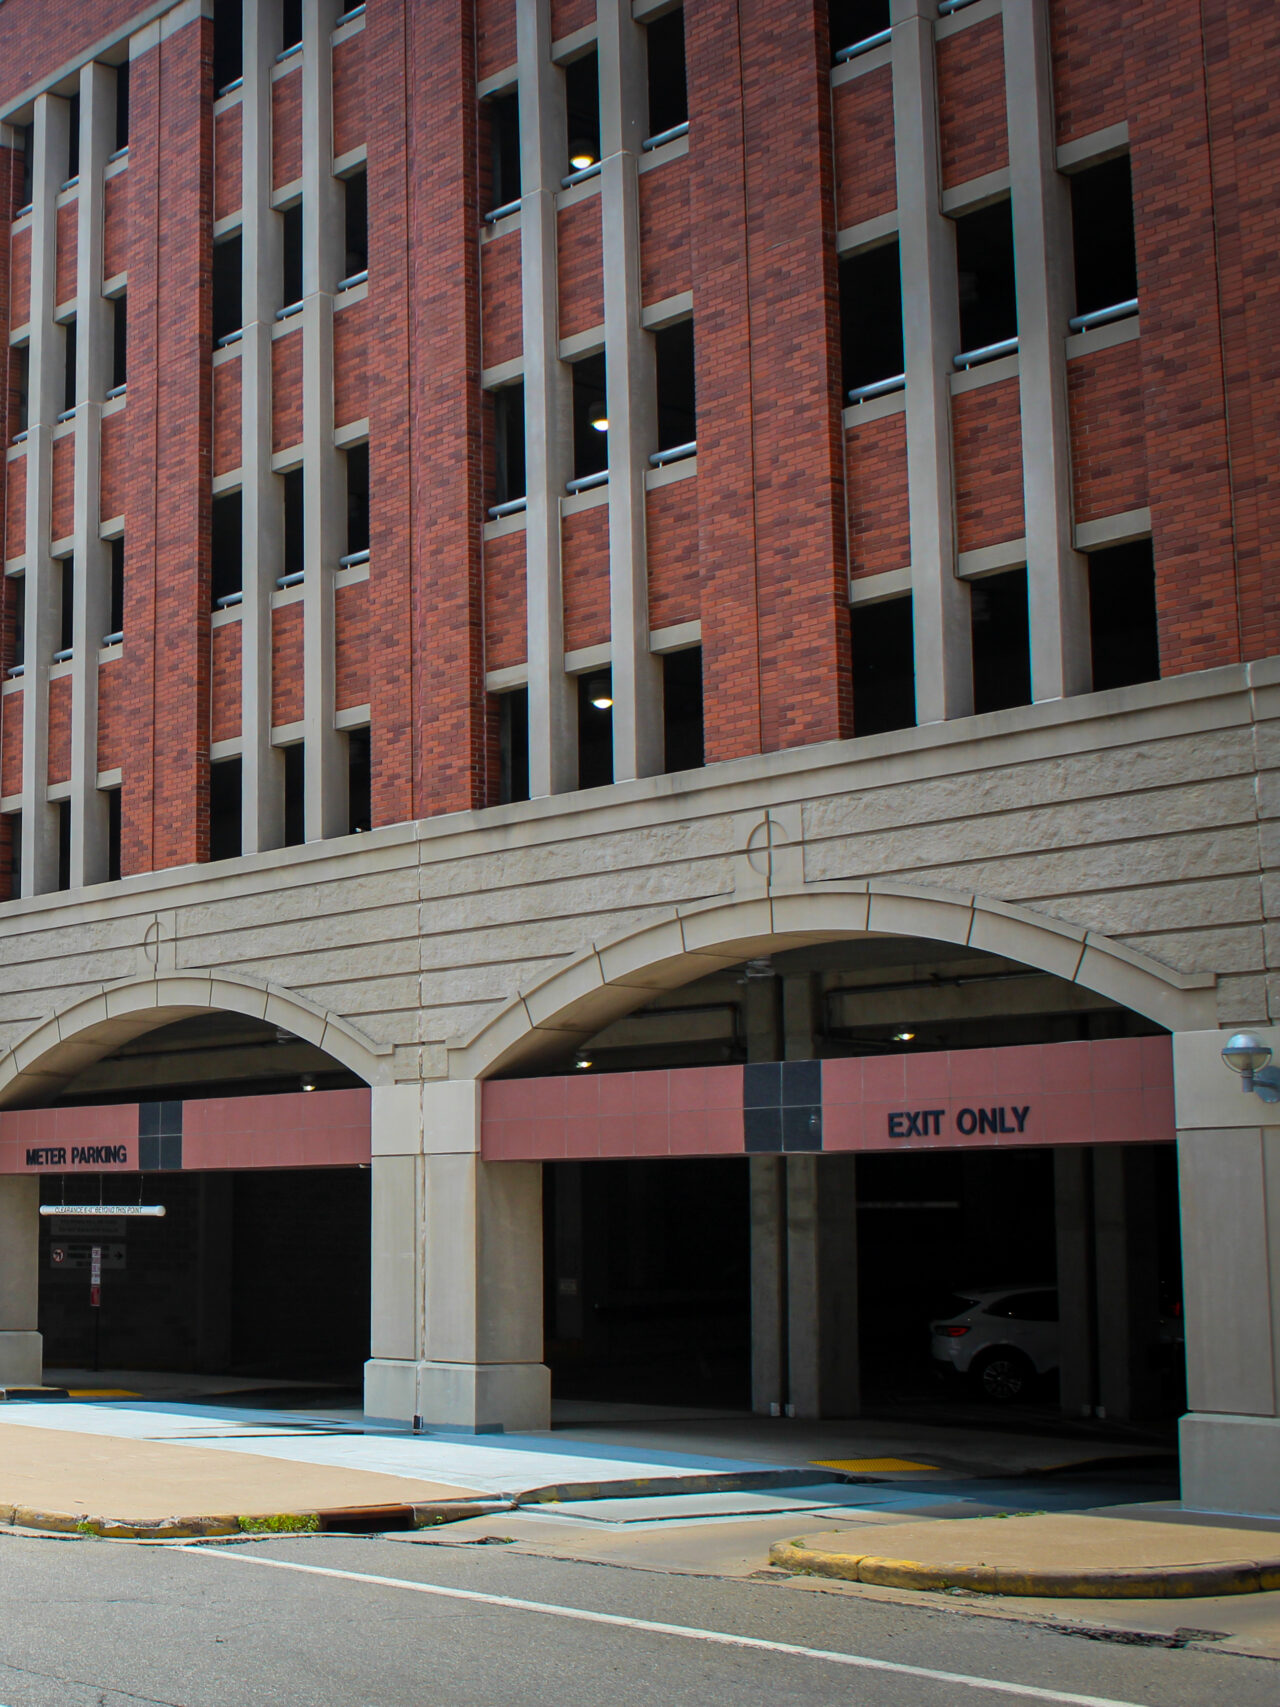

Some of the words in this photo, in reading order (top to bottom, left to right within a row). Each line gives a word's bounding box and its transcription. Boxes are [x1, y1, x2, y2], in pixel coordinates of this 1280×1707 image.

[888, 1109, 946, 1138] EXIT
[956, 1106, 1030, 1135] ONLY
[26, 1147, 67, 1166] METER
[71, 1145, 127, 1163] PARKING
